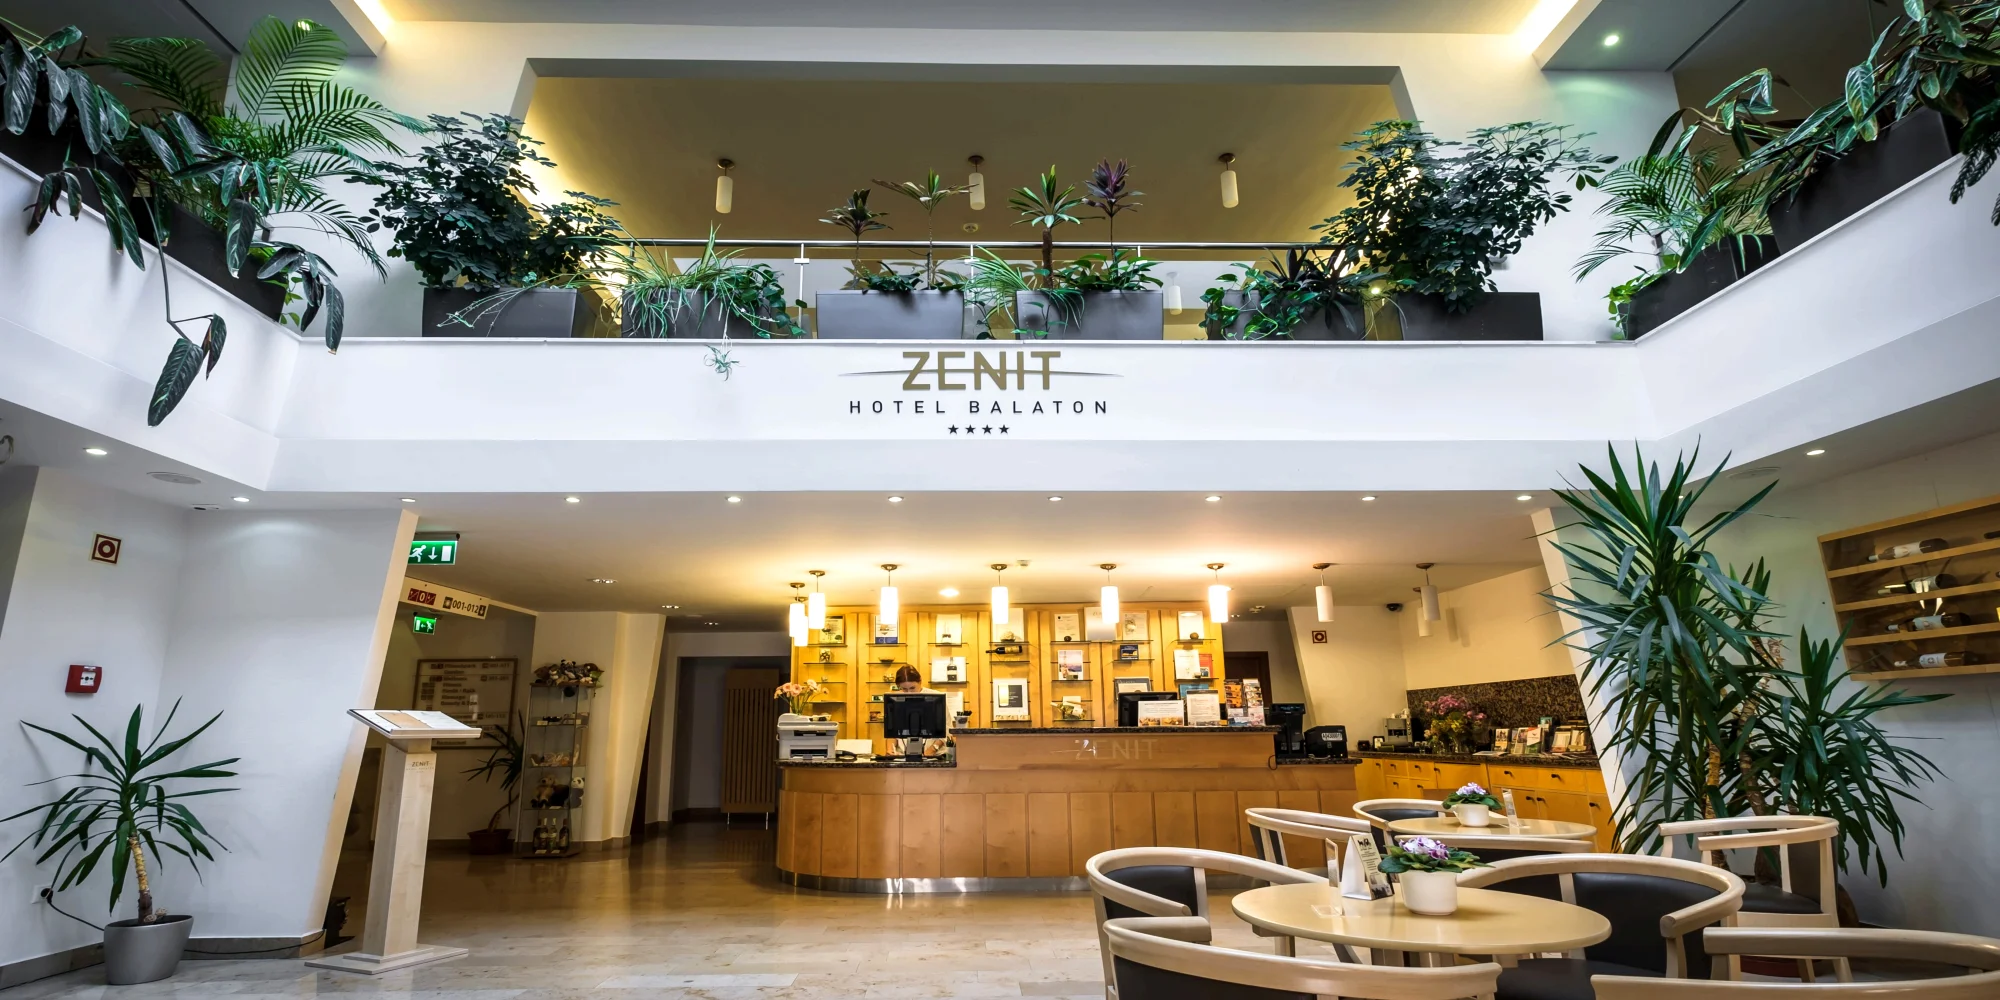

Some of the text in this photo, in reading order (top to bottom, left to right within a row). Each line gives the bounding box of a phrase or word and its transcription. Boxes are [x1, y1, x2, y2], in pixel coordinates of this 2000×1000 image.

[902, 351, 1061, 391] ZENIT
[850, 401, 1107, 413] HOTEL BALATON
[420, 592, 426, 602] 0
[452, 599, 479, 614] 001-012
[1075, 739, 1158, 760] ZENIT
